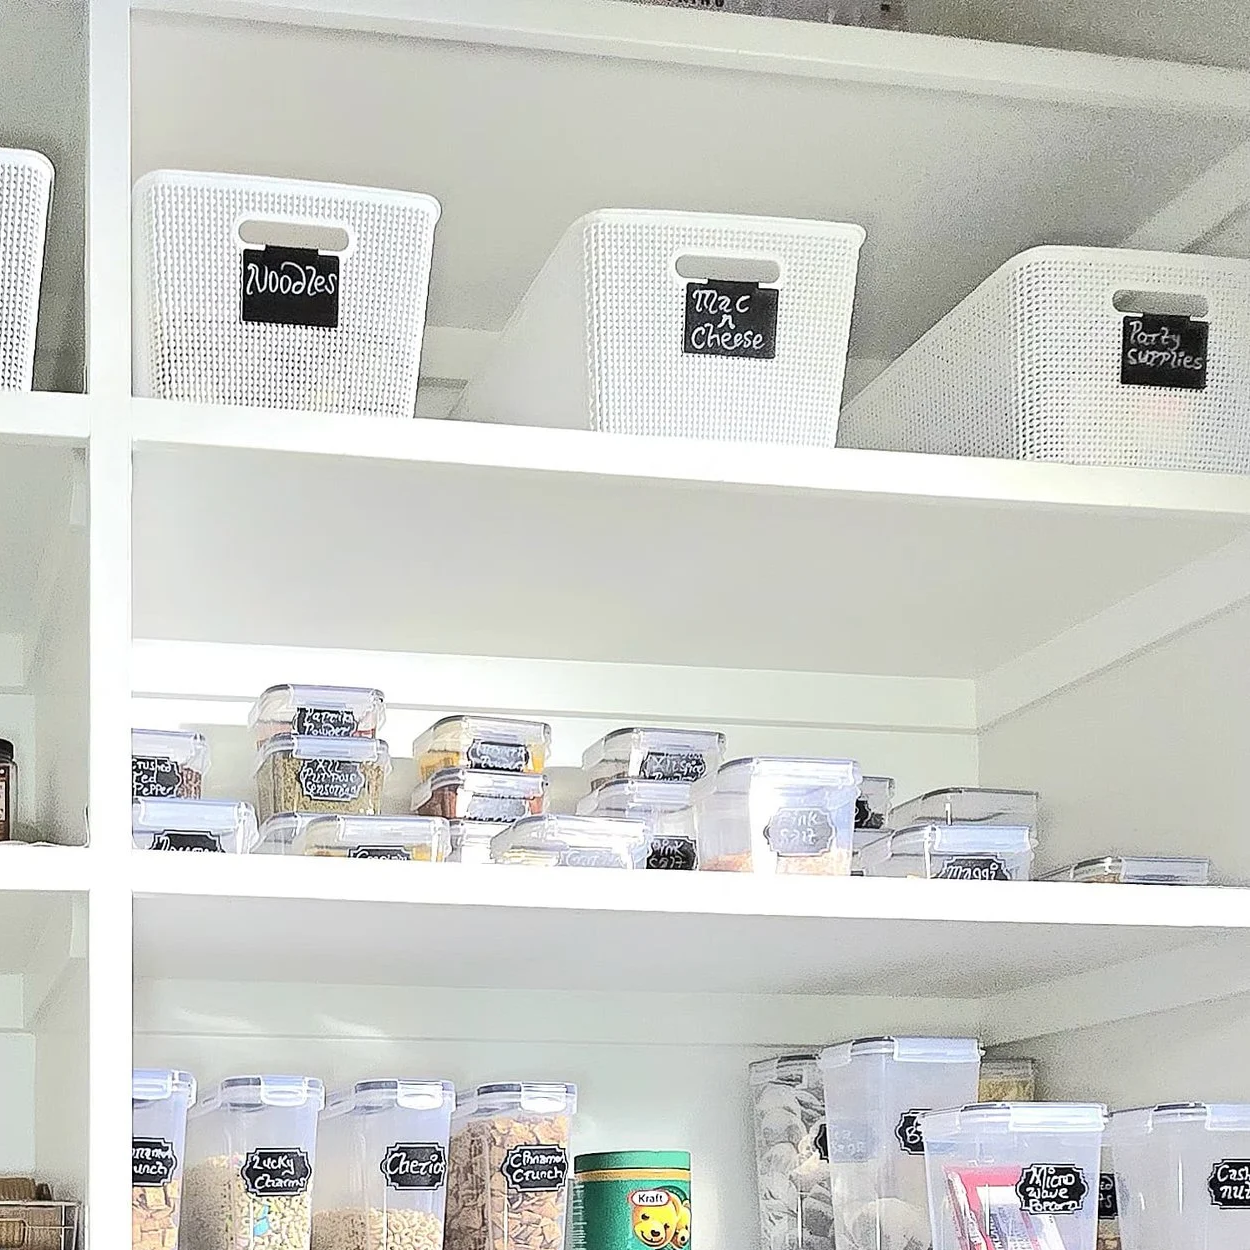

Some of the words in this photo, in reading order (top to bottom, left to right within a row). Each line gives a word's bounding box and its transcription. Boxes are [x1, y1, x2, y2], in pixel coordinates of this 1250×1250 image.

[246, 261, 338, 296] Noodles
[691, 323, 766, 350] Cheese
[1129, 320, 1181, 351] Party
[511, 1166, 564, 1184] Crunch
[638, 1193, 664, 1204] Kraft
